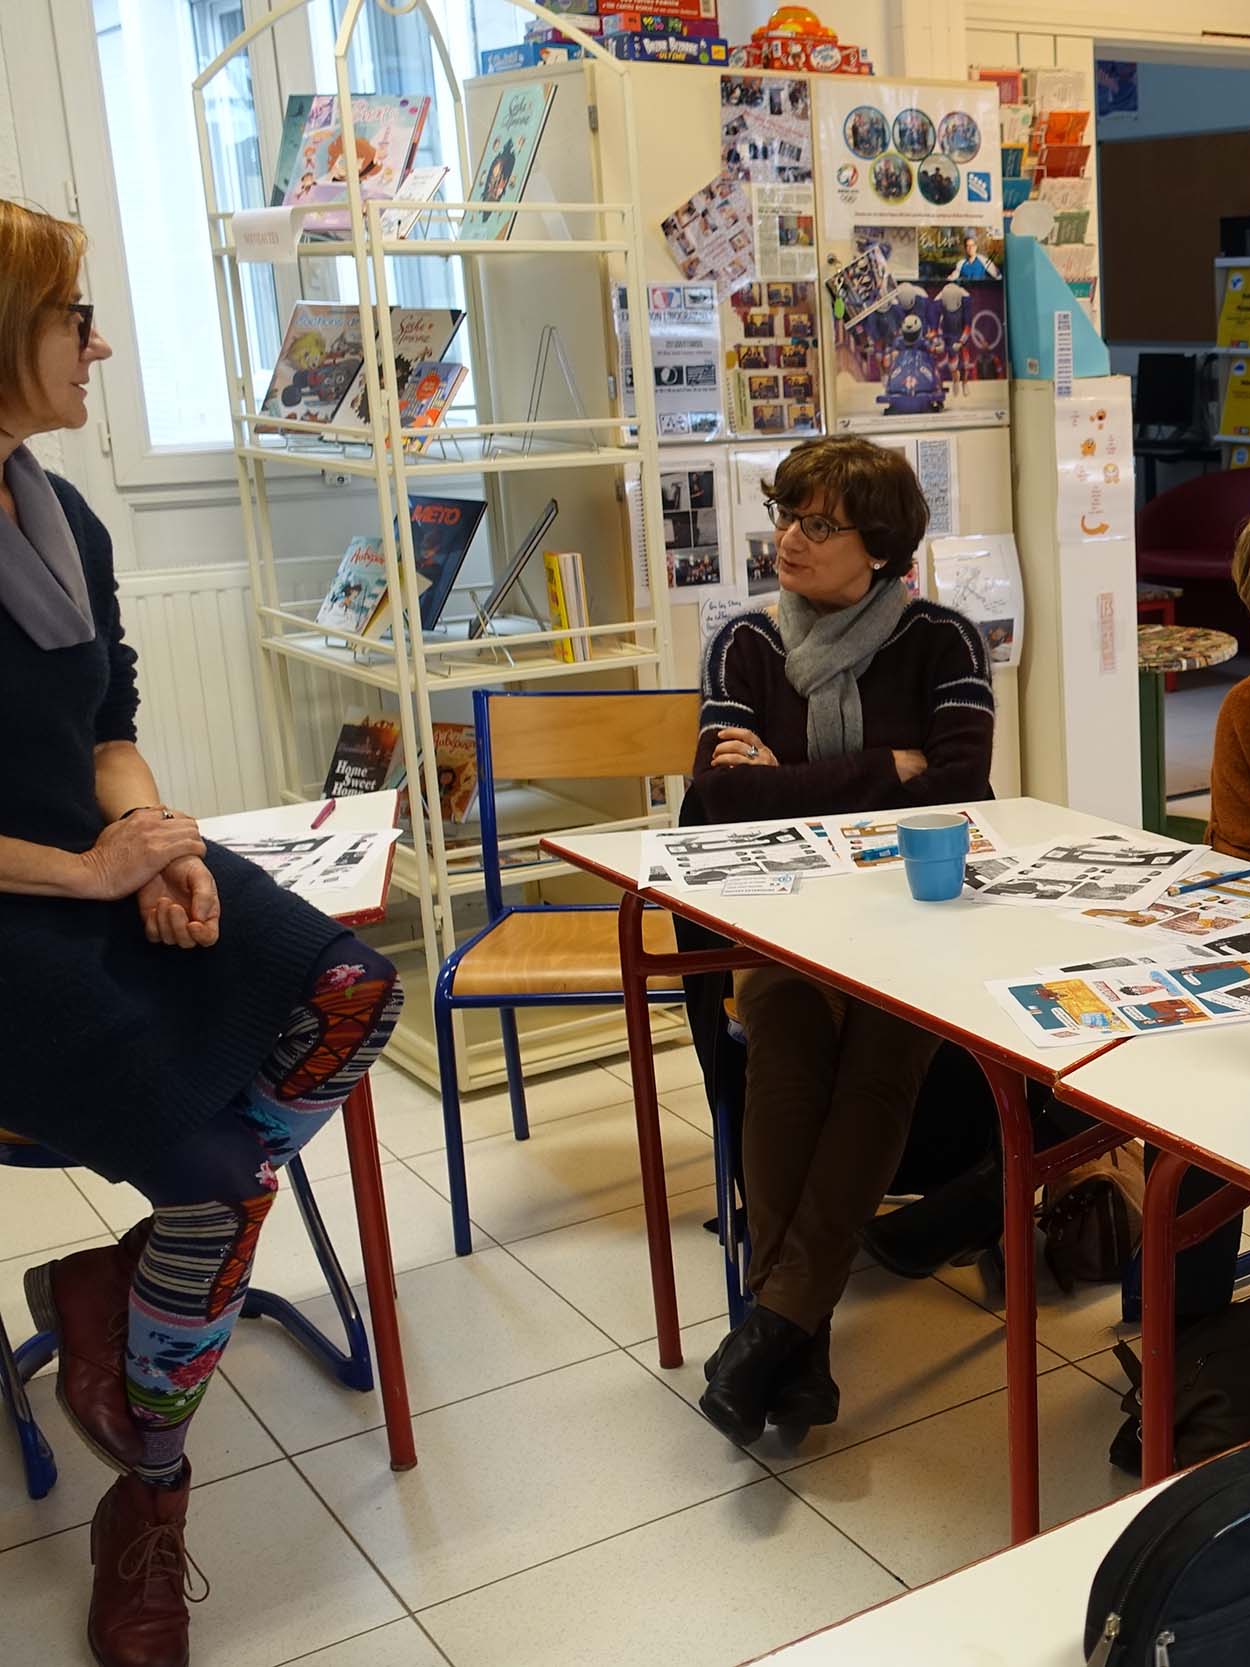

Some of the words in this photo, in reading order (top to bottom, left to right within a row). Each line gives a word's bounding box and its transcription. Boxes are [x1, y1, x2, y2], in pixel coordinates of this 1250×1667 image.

[335, 760, 368, 777] Home
[331, 782, 364, 796] Home
[343, 774, 376, 791] Sweet
